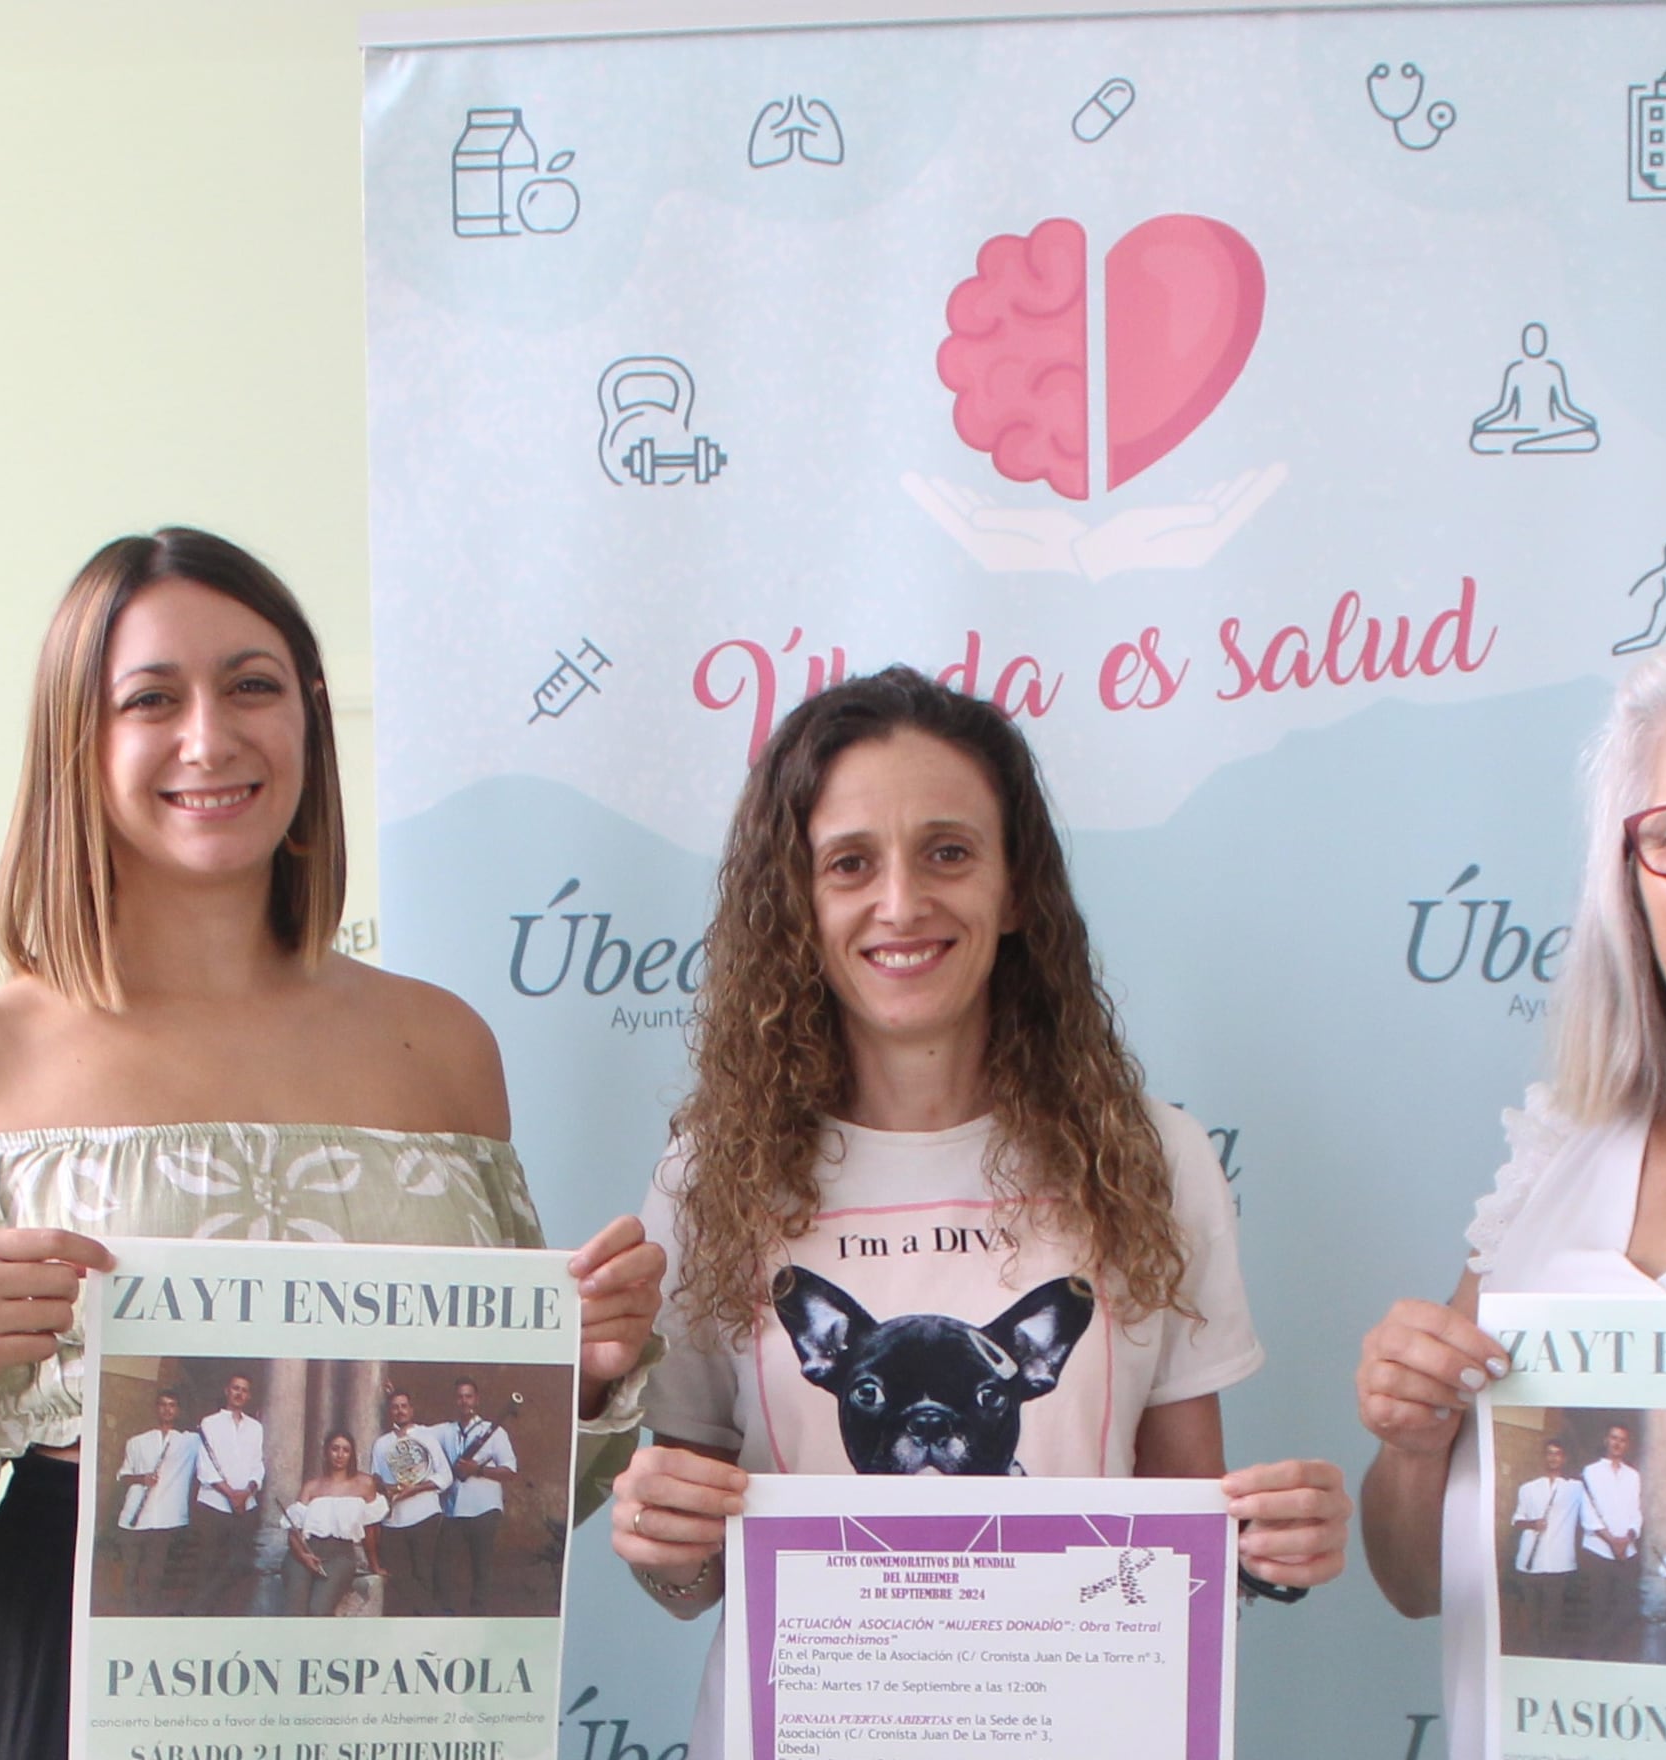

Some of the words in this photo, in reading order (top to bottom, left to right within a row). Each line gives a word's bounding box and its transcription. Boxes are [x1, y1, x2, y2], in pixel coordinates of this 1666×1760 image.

[1099, 626, 1190, 711] es
[1217, 576, 1498, 701] salud
[509, 877, 705, 998] Úbe
[902, 1234, 919, 1254] a
[112, 1276, 263, 1322] ZAYT
[281, 1280, 560, 1329] ENSEMBLE
[1497, 1330, 1634, 1374] ZAYT
[826, 1555, 857, 1567] ACTOS
[859, 1555, 949, 1568] CONMEMORATIVOS
[952, 1555, 970, 1568] DÍA
[973, 1556, 1016, 1568] MUNDIAL
[882, 1571, 901, 1583] DEL
[904, 1572, 959, 1584] ALZHEIMER
[859, 1587, 871, 1599] 21
[874, 1587, 888, 1599] DE
[890, 1587, 952, 1600] SEPTIEMBRE
[958, 1588, 985, 1600] 2024
[777, 1616, 852, 1629] ACTUACIÓN
[857, 1617, 934, 1630] ASOCIACIÓN
[1078, 1620, 1110, 1632] Obra
[1115, 1620, 1161, 1632] Teatral
[778, 1648, 793, 1661] En
[796, 1648, 808, 1660] el
[811, 1648, 854, 1663] Parque
[856, 1648, 872, 1661] de
[874, 1648, 887, 1664] la
[889, 1649, 953, 1661] Asociación
[956, 1649, 978, 1664] (C/
[980, 1650, 1030, 1662] Cronista
[1033, 1651, 1062, 1663] Juan
[1065, 1650, 1082, 1663] De
[1084, 1651, 1099, 1663] La
[1102, 1651, 1134, 1663] Torre
[1153, 1651, 1165, 1664] 3,
[107, 1653, 281, 1696] PASIÓN
[298, 1652, 532, 1695] ESPAÑOLA
[777, 1678, 817, 1691] Fecha:
[821, 1680, 862, 1691] Martes
[866, 1679, 880, 1691] 17
[883, 1679, 899, 1692] de
[901, 1680, 971, 1693] Septiembre
[974, 1683, 982, 1692] a
[985, 1681, 1003, 1693] las
[1006, 1680, 1047, 1693] 12:00h
